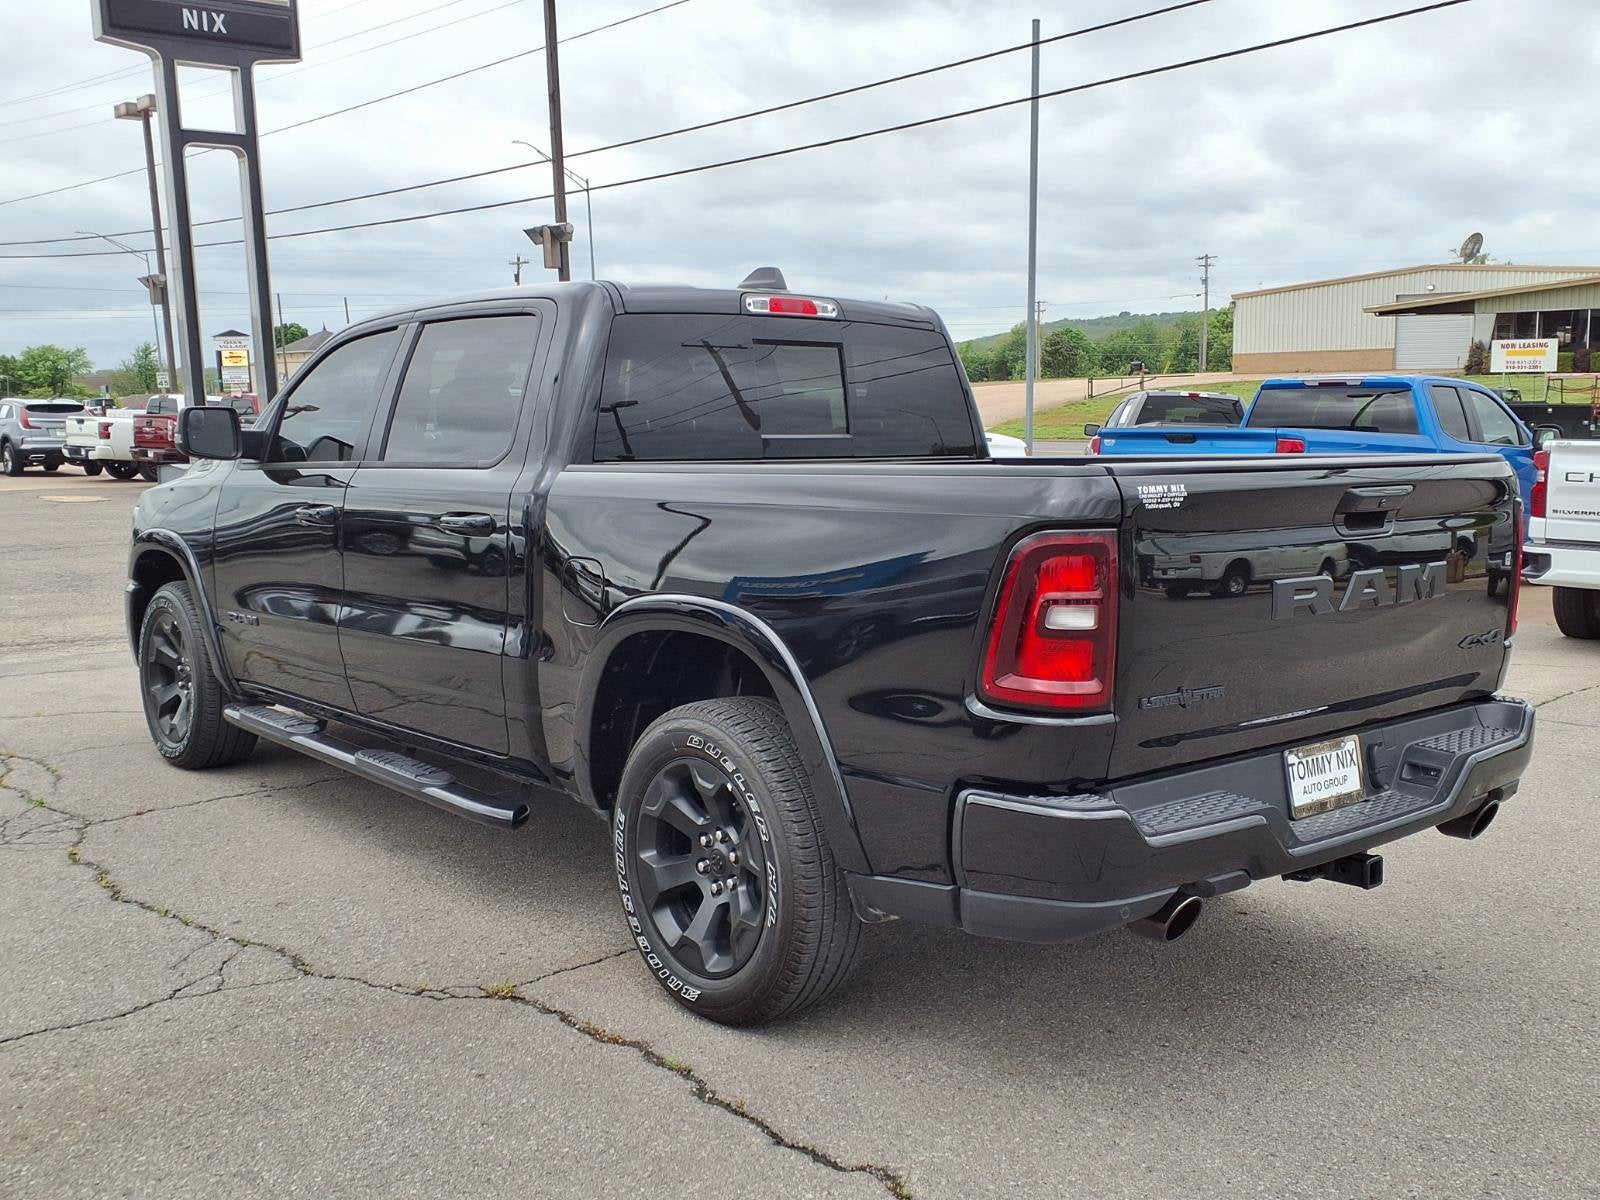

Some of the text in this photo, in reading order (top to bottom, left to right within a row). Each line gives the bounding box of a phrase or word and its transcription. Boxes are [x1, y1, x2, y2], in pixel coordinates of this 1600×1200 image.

[182, 8, 227, 34] NIX
[1137, 484, 1186, 494] TOMMY NIX
[1272, 561, 1448, 620] RAM
[1287, 753, 1332, 783] TOMMY
[1336, 748, 1357, 771] NIX
[687, 735, 769, 842] DUELER
[1302, 774, 1349, 796] AUTO GROUP
[616, 807, 702, 1002] BRIDGESTONE
